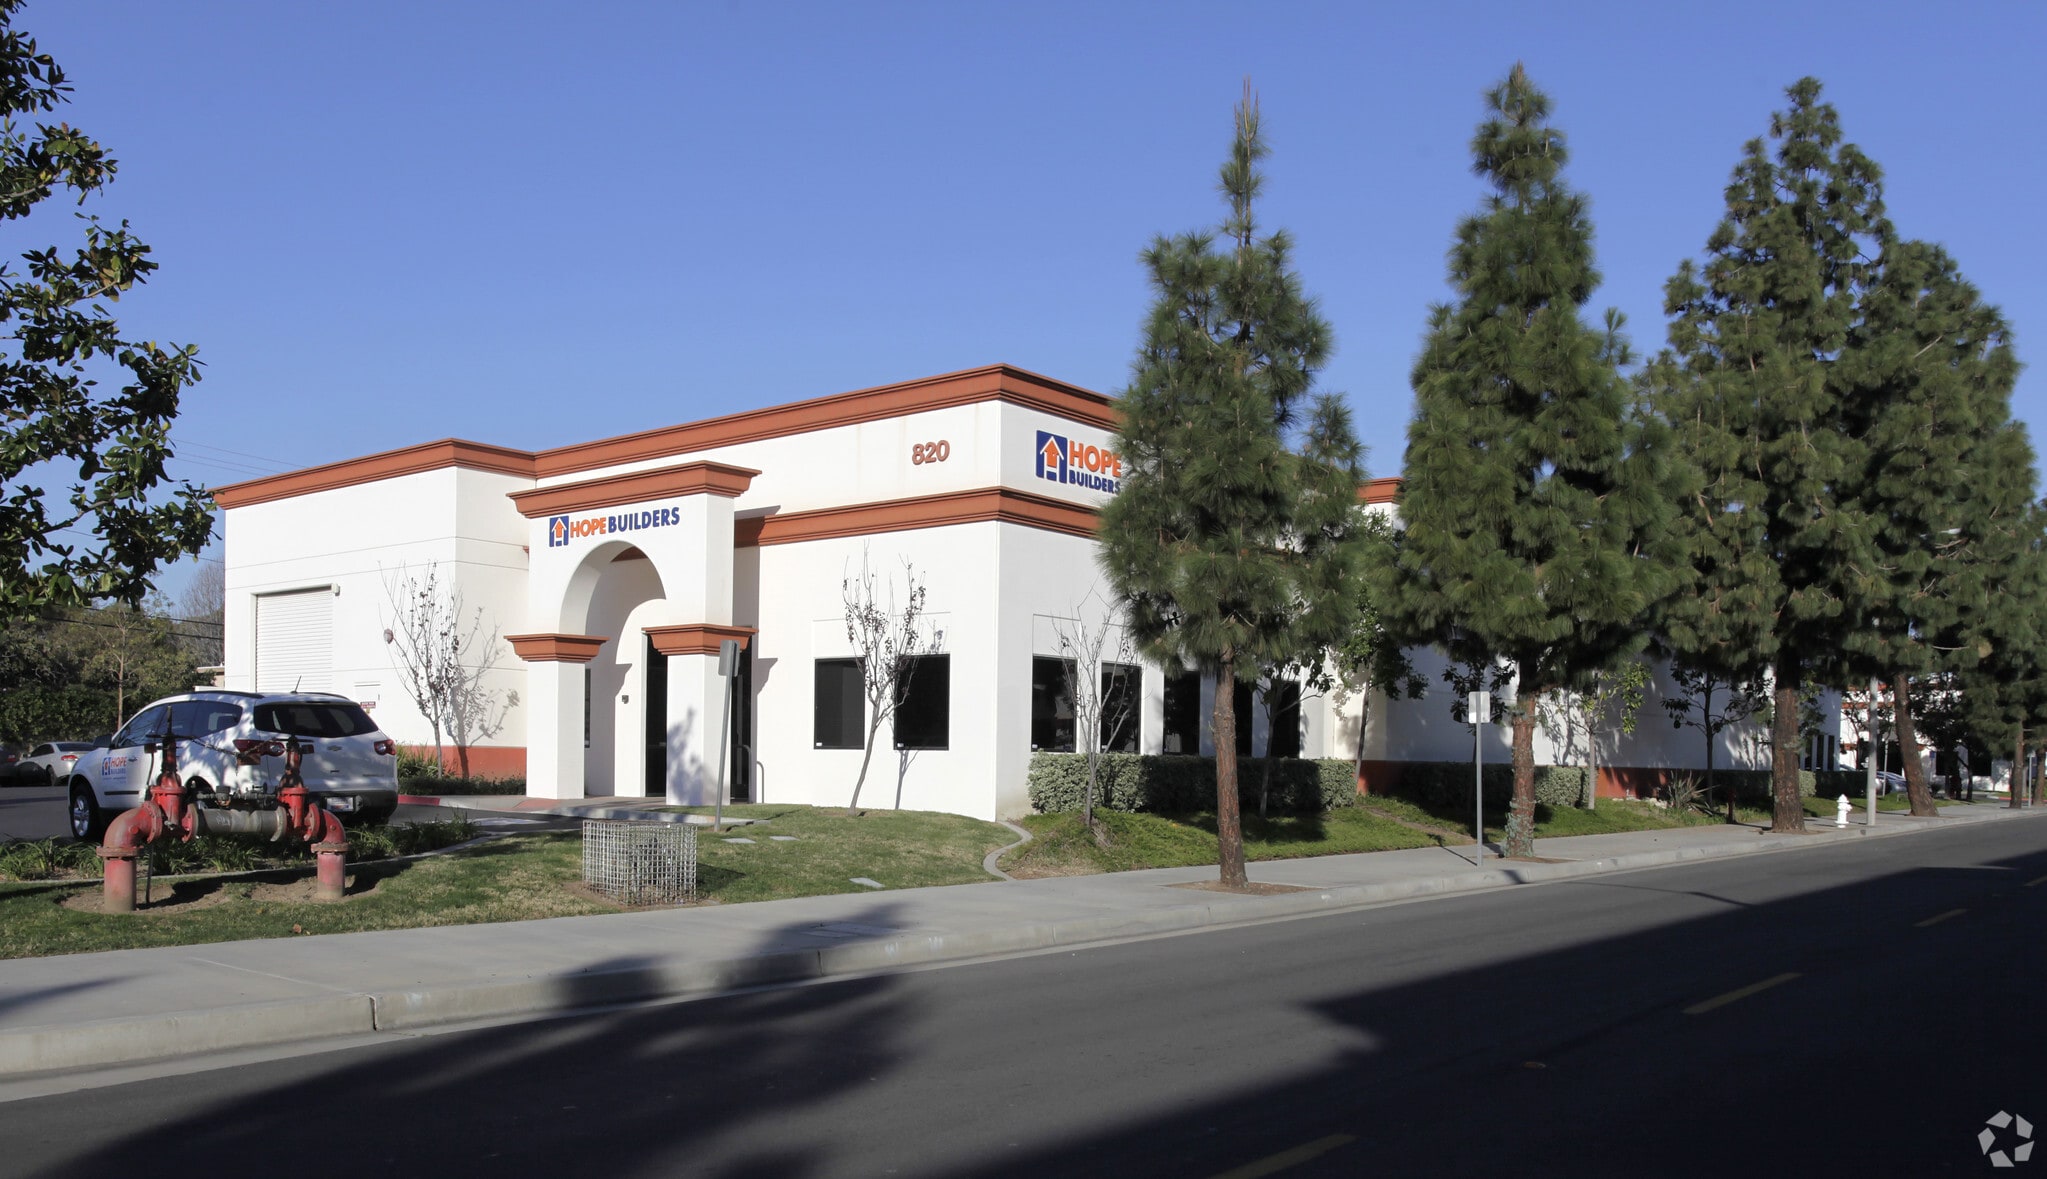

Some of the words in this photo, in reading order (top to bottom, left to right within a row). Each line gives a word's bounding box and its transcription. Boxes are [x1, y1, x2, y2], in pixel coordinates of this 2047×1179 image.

[912, 440, 950, 465] 820
[1069, 440, 1121, 478] HOPE
[1069, 470, 1121, 496] BUILDERS
[570, 517, 606, 538] HOPE
[608, 507, 680, 533] BUILDERS
